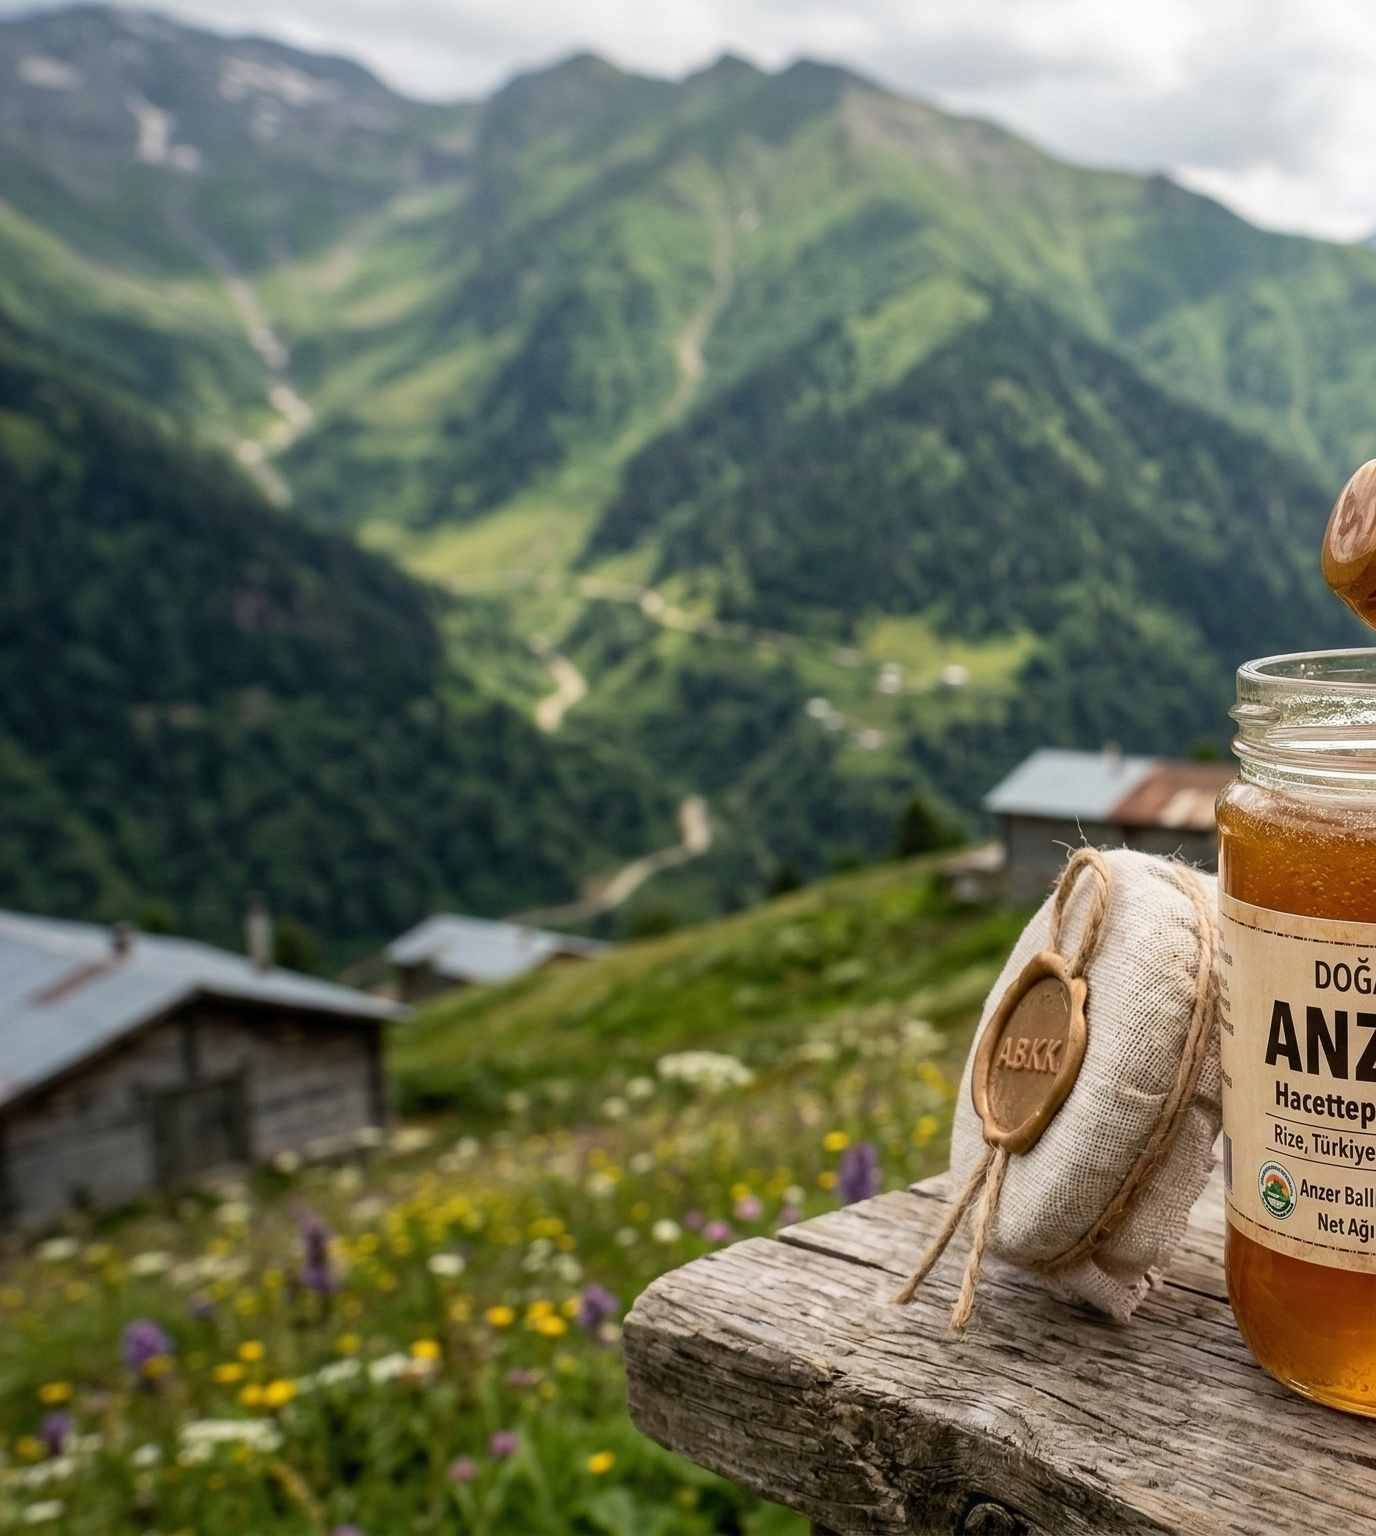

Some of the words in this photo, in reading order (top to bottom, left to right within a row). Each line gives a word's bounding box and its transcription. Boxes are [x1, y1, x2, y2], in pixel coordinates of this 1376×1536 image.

[1274, 1123, 1309, 1153] Rize,
[1311, 1132, 1376, 1167] Türkiye
[1299, 1178, 1341, 1204] Anzer
[1317, 1211, 1345, 1236] Net
